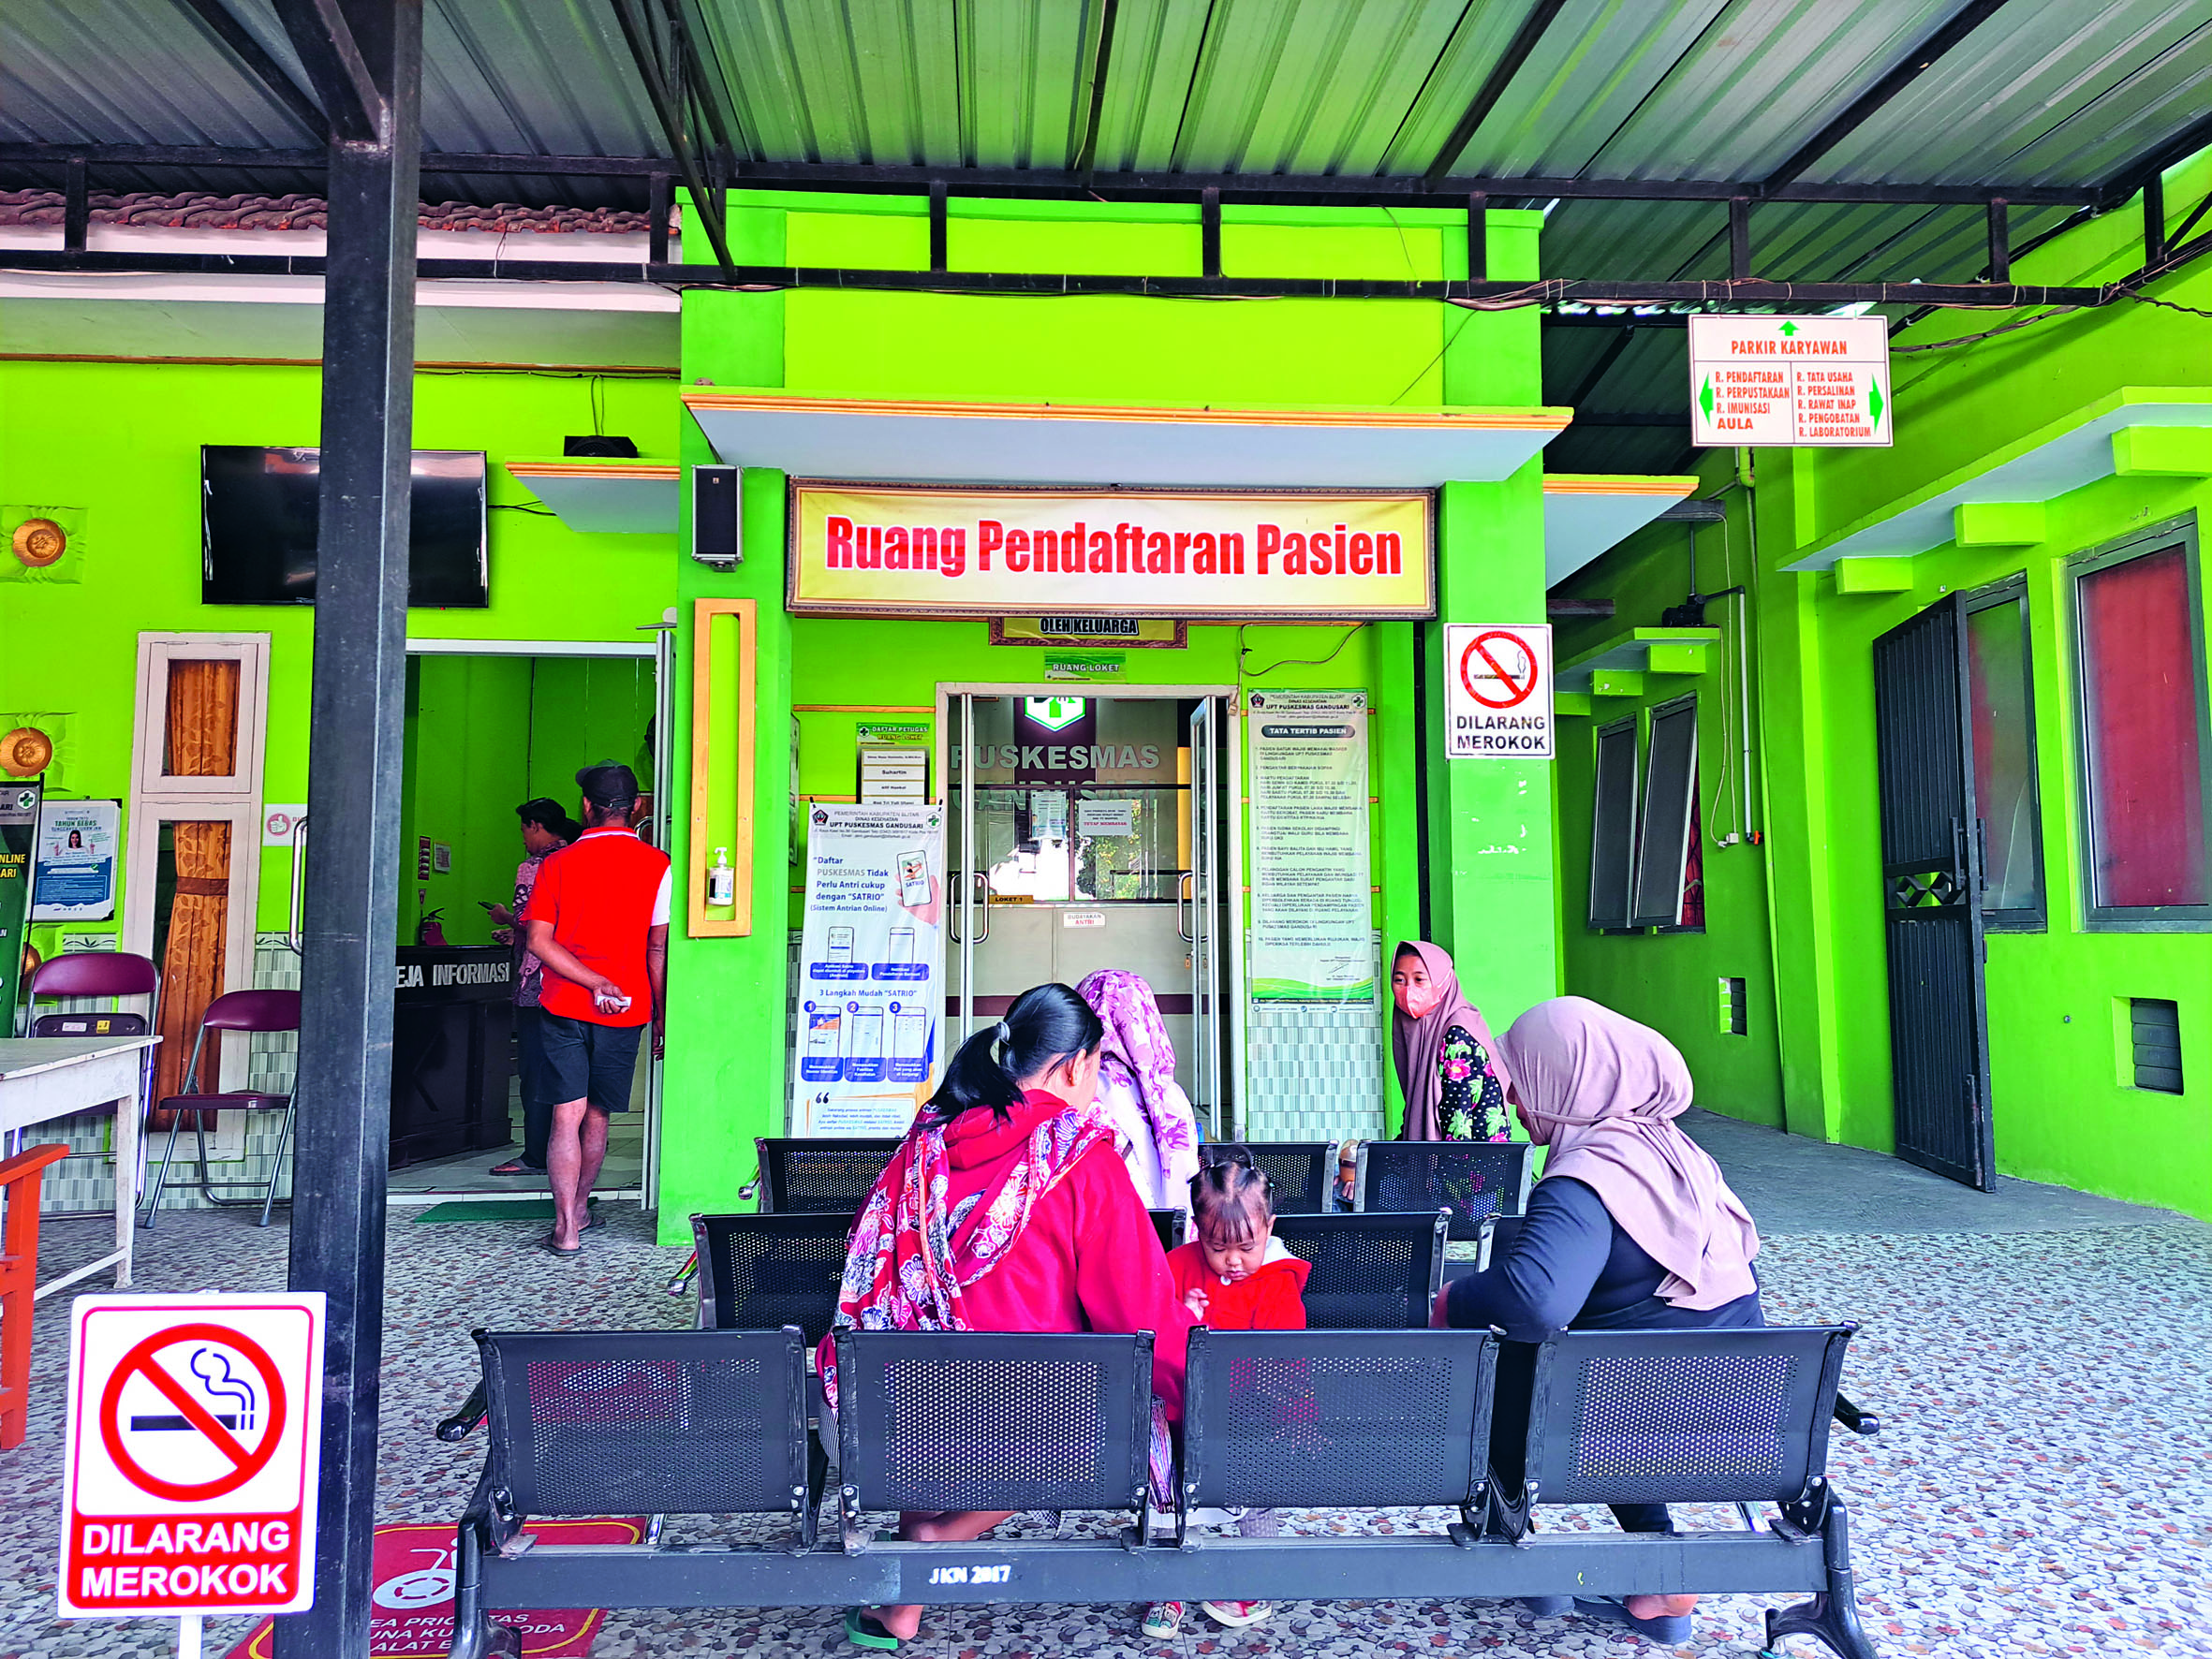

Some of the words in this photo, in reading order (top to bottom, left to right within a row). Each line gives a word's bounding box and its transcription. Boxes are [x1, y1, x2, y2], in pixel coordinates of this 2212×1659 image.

[1732, 341, 1777, 355] PARKIR
[1780, 341, 1847, 355] KARYAWAN
[1716, 372, 1724, 383] R.
[1727, 372, 1783, 383] PENDAFTARAN
[1797, 373, 1805, 382] R.
[1807, 373, 1825, 382] TATA
[1827, 373, 1852, 382] USAHA
[1717, 388, 1724, 398] R.
[1727, 388, 1790, 398] PERPUSTAKAAN
[1798, 387, 1806, 395] R.
[1808, 387, 1854, 395] PERSALINAN
[1717, 404, 1725, 414] R.
[1728, 404, 1770, 414] IMUNISASI
[1798, 400, 1806, 409] R.
[1808, 400, 1835, 409] RAWAT
[1837, 400, 1856, 409] INAP
[1718, 418, 1753, 430] AULA
[1799, 414, 1806, 423] R.
[1809, 414, 1860, 423] PENGOBATAN
[1799, 427, 1807, 436] R.
[1809, 427, 1871, 436] LABORATORIUM
[826, 517, 966, 577] Ruang
[979, 521, 1245, 575] Pendaftaran
[1257, 524, 1402, 576] Pasien
[1040, 618, 1071, 633] OLEH
[1073, 619, 1138, 635] KELUARGA
[1457, 716, 1545, 729] DILARANG
[1458, 736, 1545, 749] MEROKOK
[951, 745, 1159, 770] PUSKESMAS
[862, 881, 885, 890] cukup
[816, 892, 846, 902] dengan
[395, 965, 423, 988] EJA
[433, 962, 510, 986] INFORMASI
[82, 1521, 289, 1554] DILARANG
[929, 1567, 967, 1584] JKN
[970, 1564, 1011, 1583] 2017
[81, 1564, 288, 1597] MEROKOK
[371, 1619, 397, 1627] EA
[371, 1641, 435, 1651] ALAT
